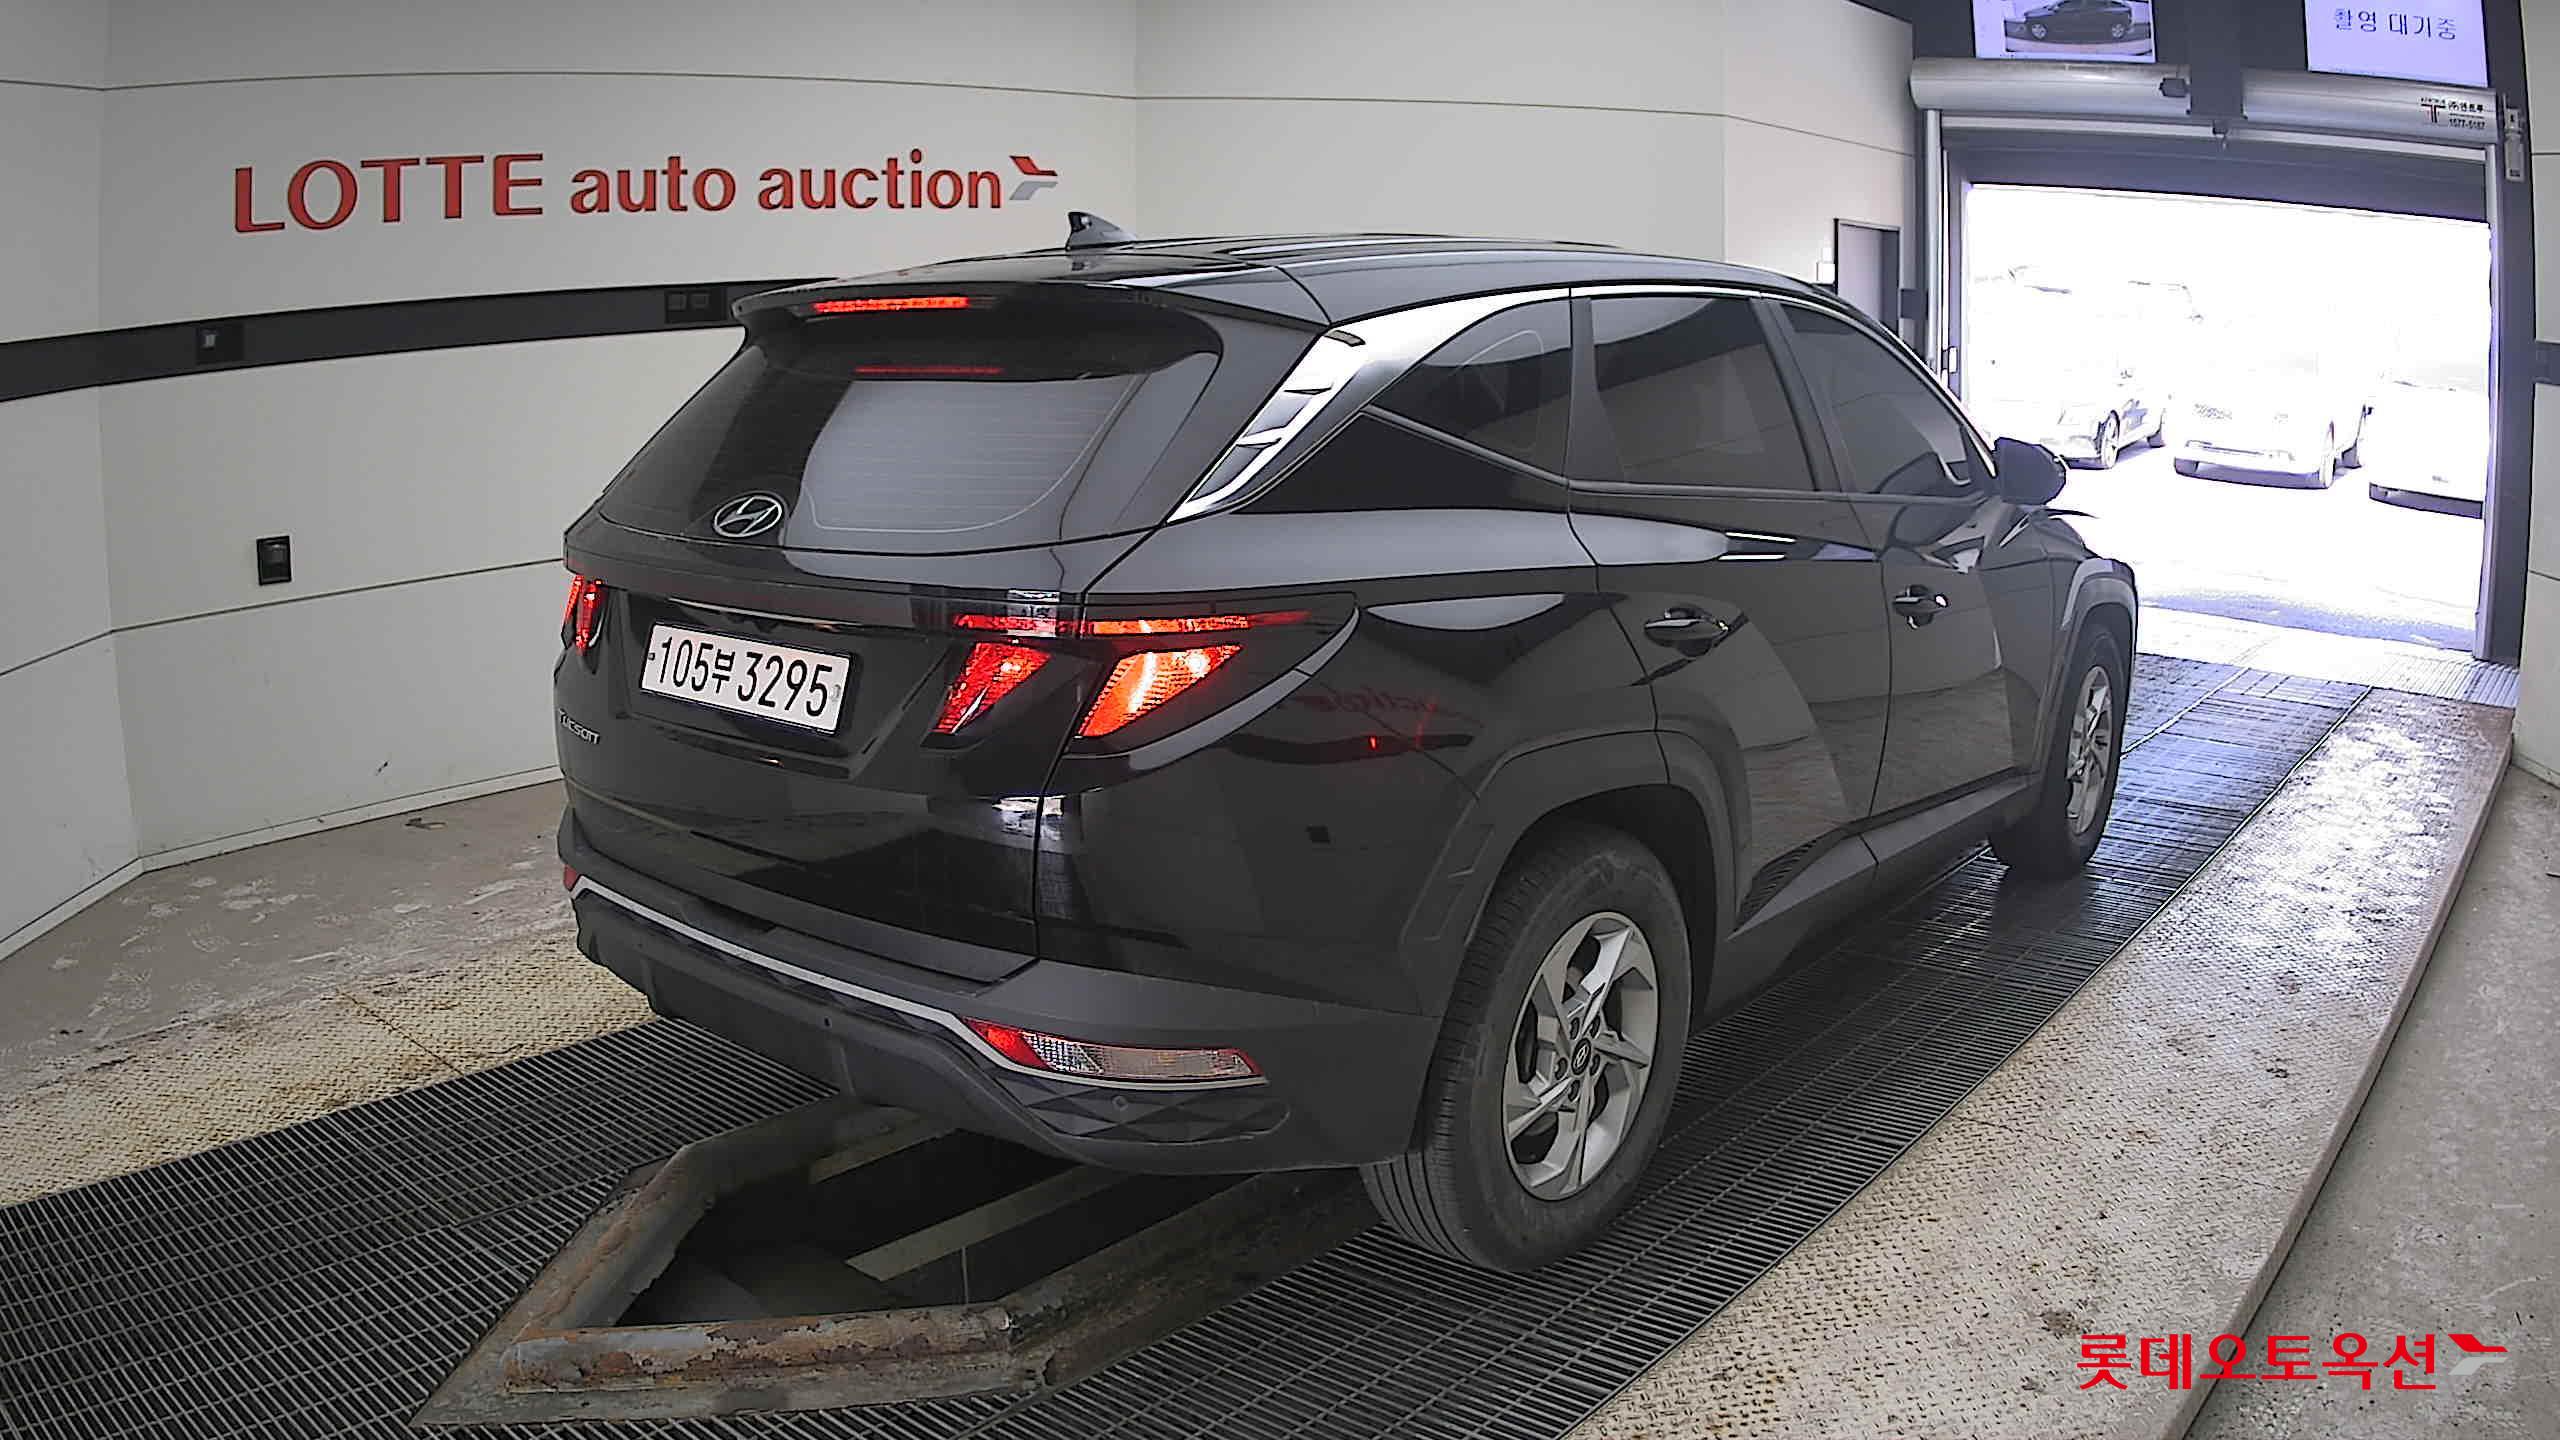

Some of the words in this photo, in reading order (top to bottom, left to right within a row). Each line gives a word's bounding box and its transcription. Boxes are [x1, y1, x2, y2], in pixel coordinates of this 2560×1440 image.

[2388, 13, 2457, 40] 대기중
[234, 153, 544, 233] LOTTE
[569, 155, 737, 214] auto
[757, 148, 1002, 211] auction
